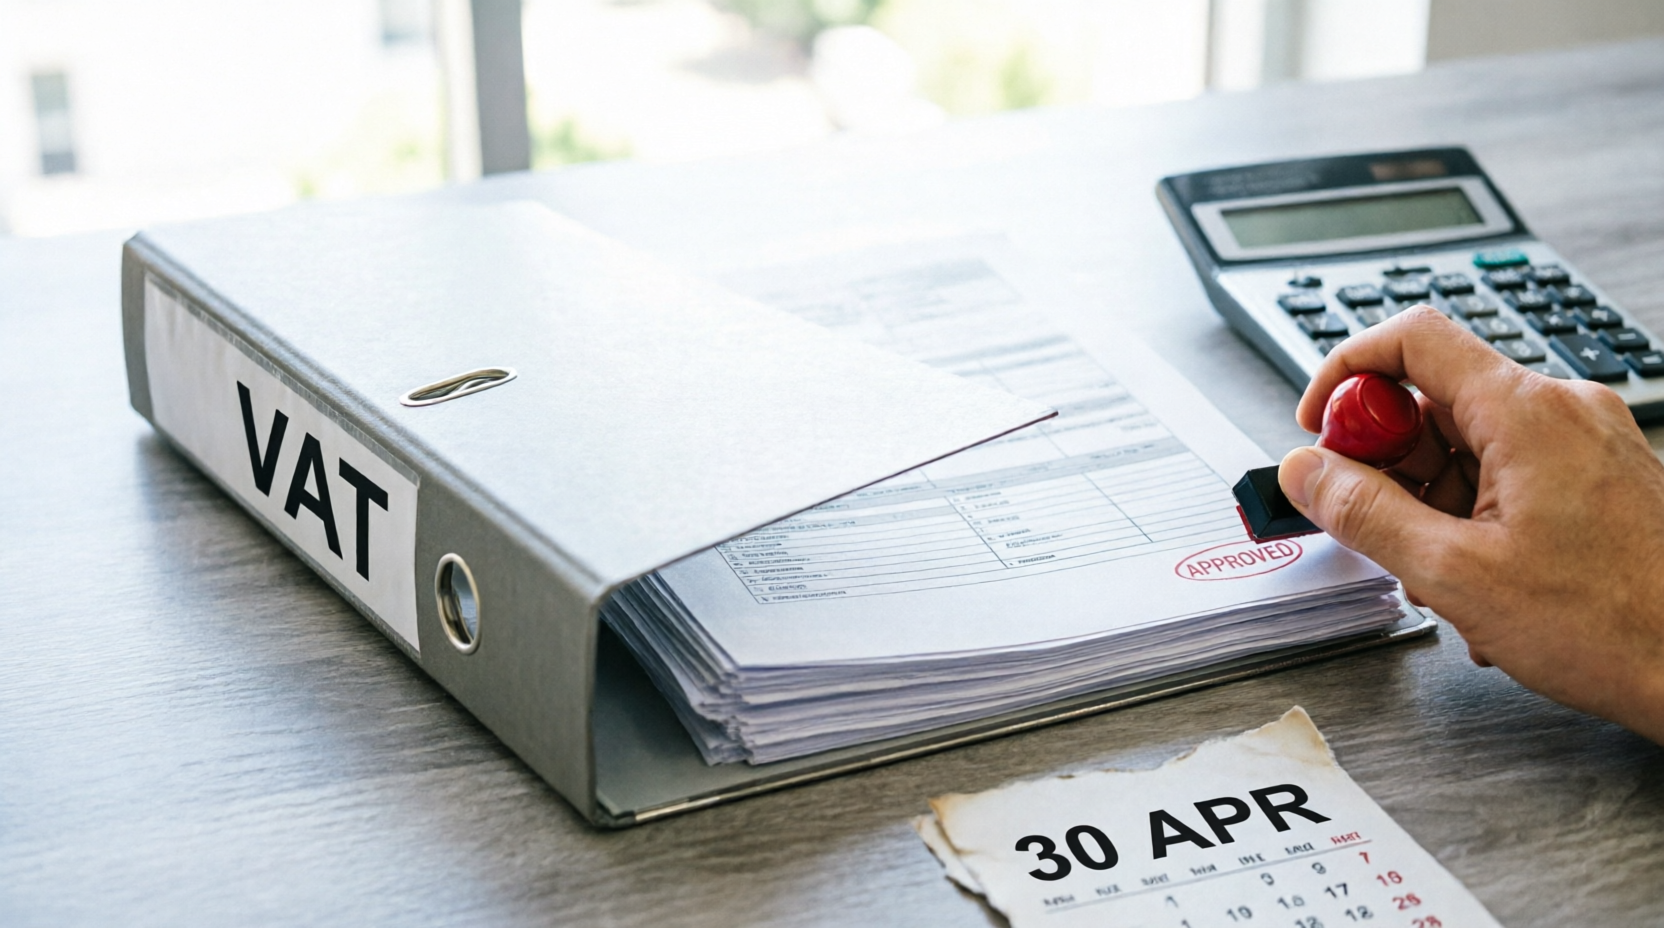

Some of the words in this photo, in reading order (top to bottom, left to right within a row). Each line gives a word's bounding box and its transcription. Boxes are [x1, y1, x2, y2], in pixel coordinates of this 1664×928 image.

[236, 379, 389, 582] VAT
[1186, 542, 1294, 577] APPROVED
[1014, 824, 1119, 881] 30
[1149, 783, 1333, 860] APR
[1324, 882, 1349, 899] 17
